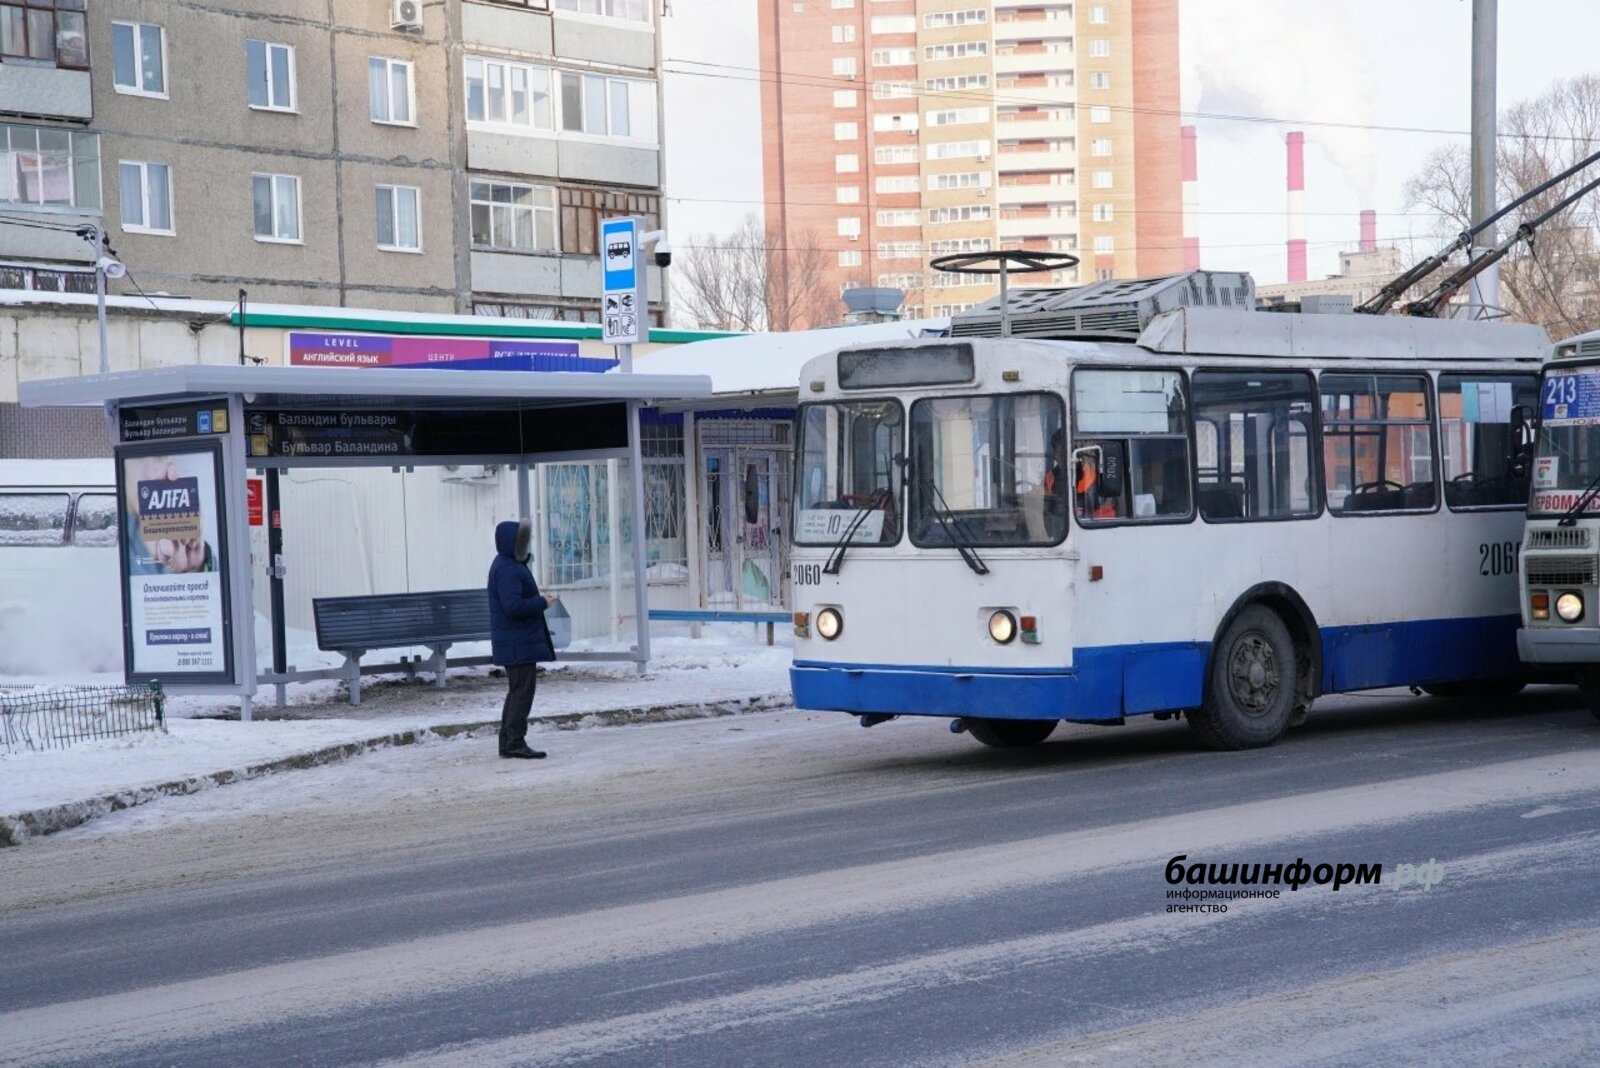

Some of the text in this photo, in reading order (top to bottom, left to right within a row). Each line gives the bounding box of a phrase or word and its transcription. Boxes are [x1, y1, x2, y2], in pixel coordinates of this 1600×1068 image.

[324, 338, 359, 348] LEVEL
[303, 352, 379, 363] АНГЛИЙСКИЙ ЯЗЫК
[1546, 376, 1577, 404] 213
[278, 412, 396, 427] Баландин бульвары
[282, 440, 398, 455] Бульвар Баландина
[827, 514, 842, 534] 10
